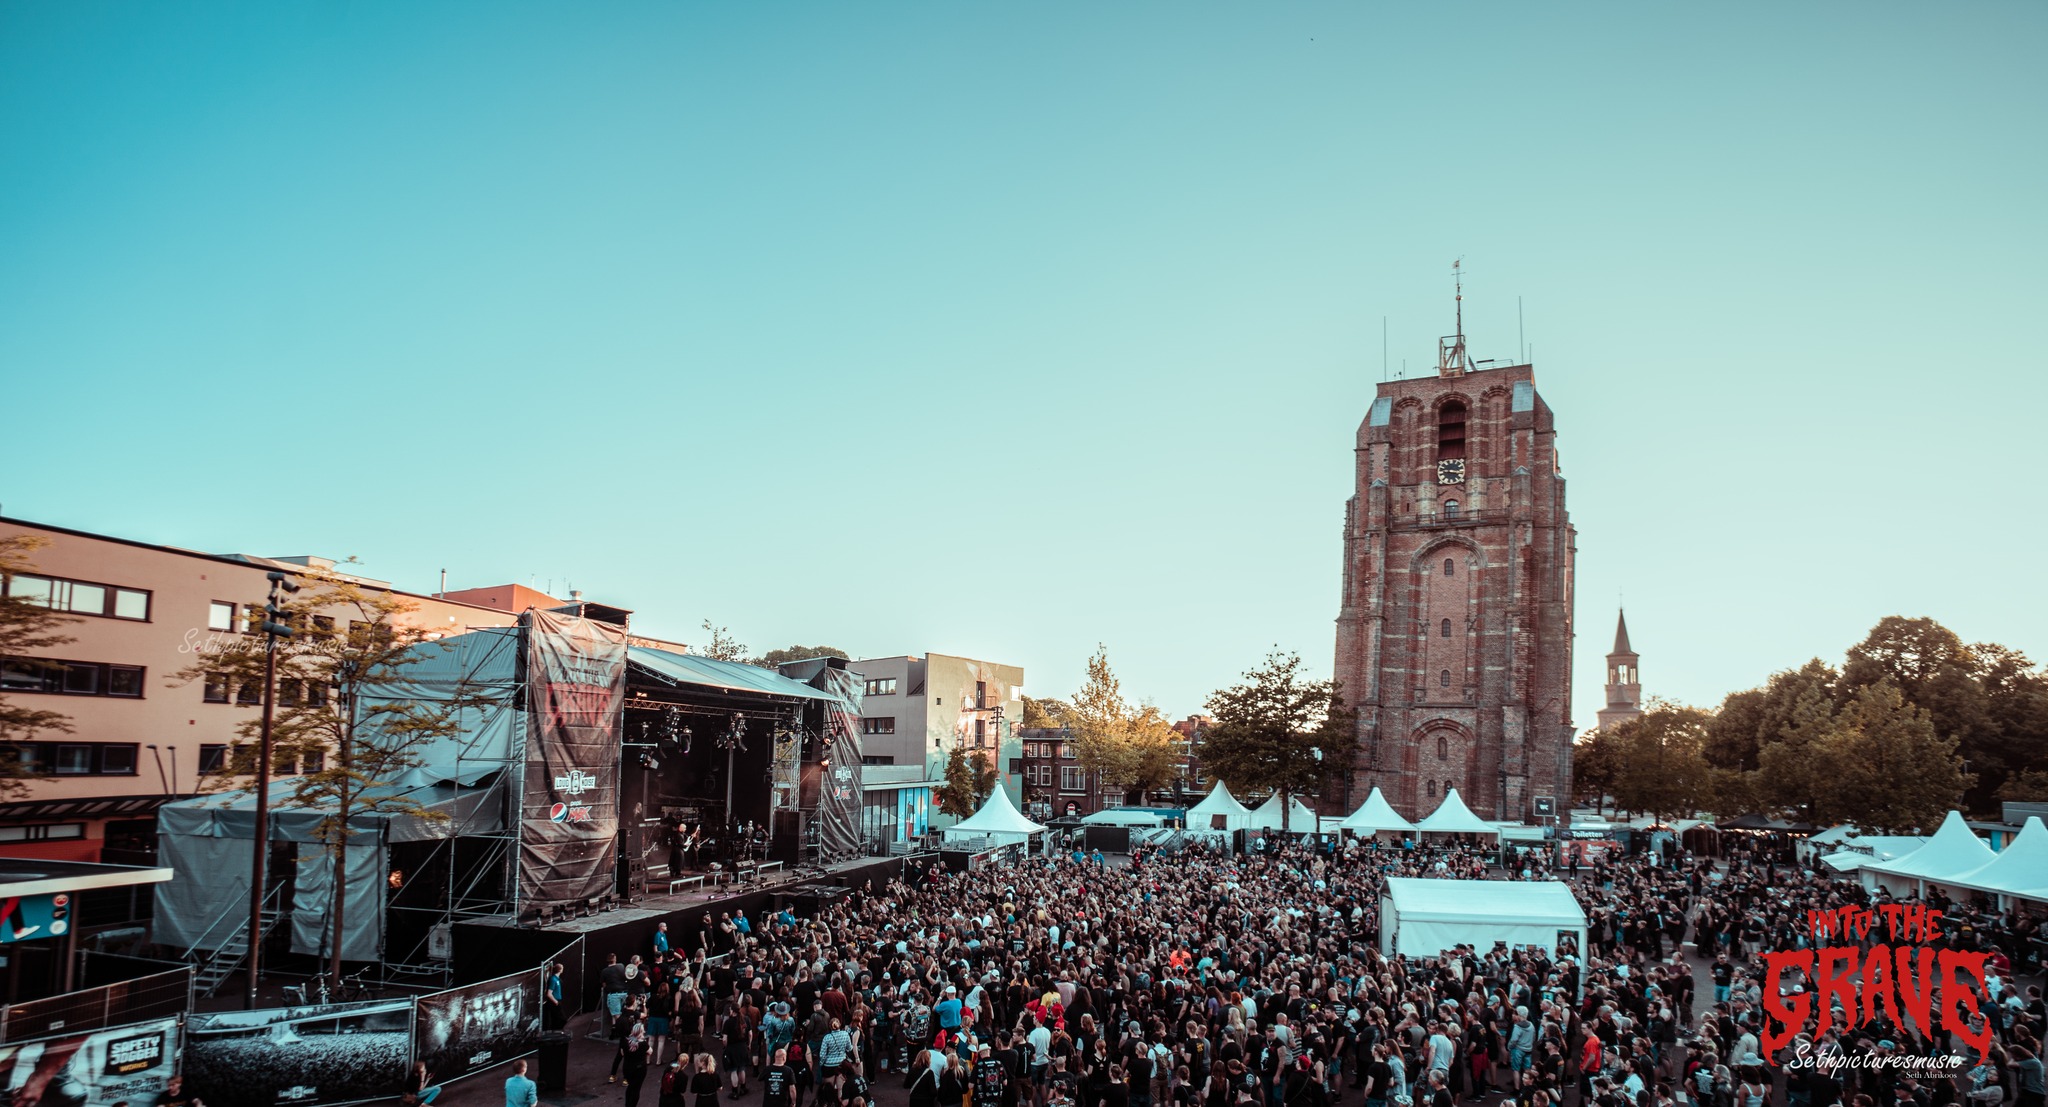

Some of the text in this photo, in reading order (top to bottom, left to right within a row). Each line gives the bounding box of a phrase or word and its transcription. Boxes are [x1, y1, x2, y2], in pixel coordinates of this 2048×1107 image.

[1572, 830, 1604, 838] Toiletten
[111, 1036, 161, 1054] SAFETY
[110, 1047, 160, 1065] JOGGER
[101, 1083, 162, 1101] PROTECTION
